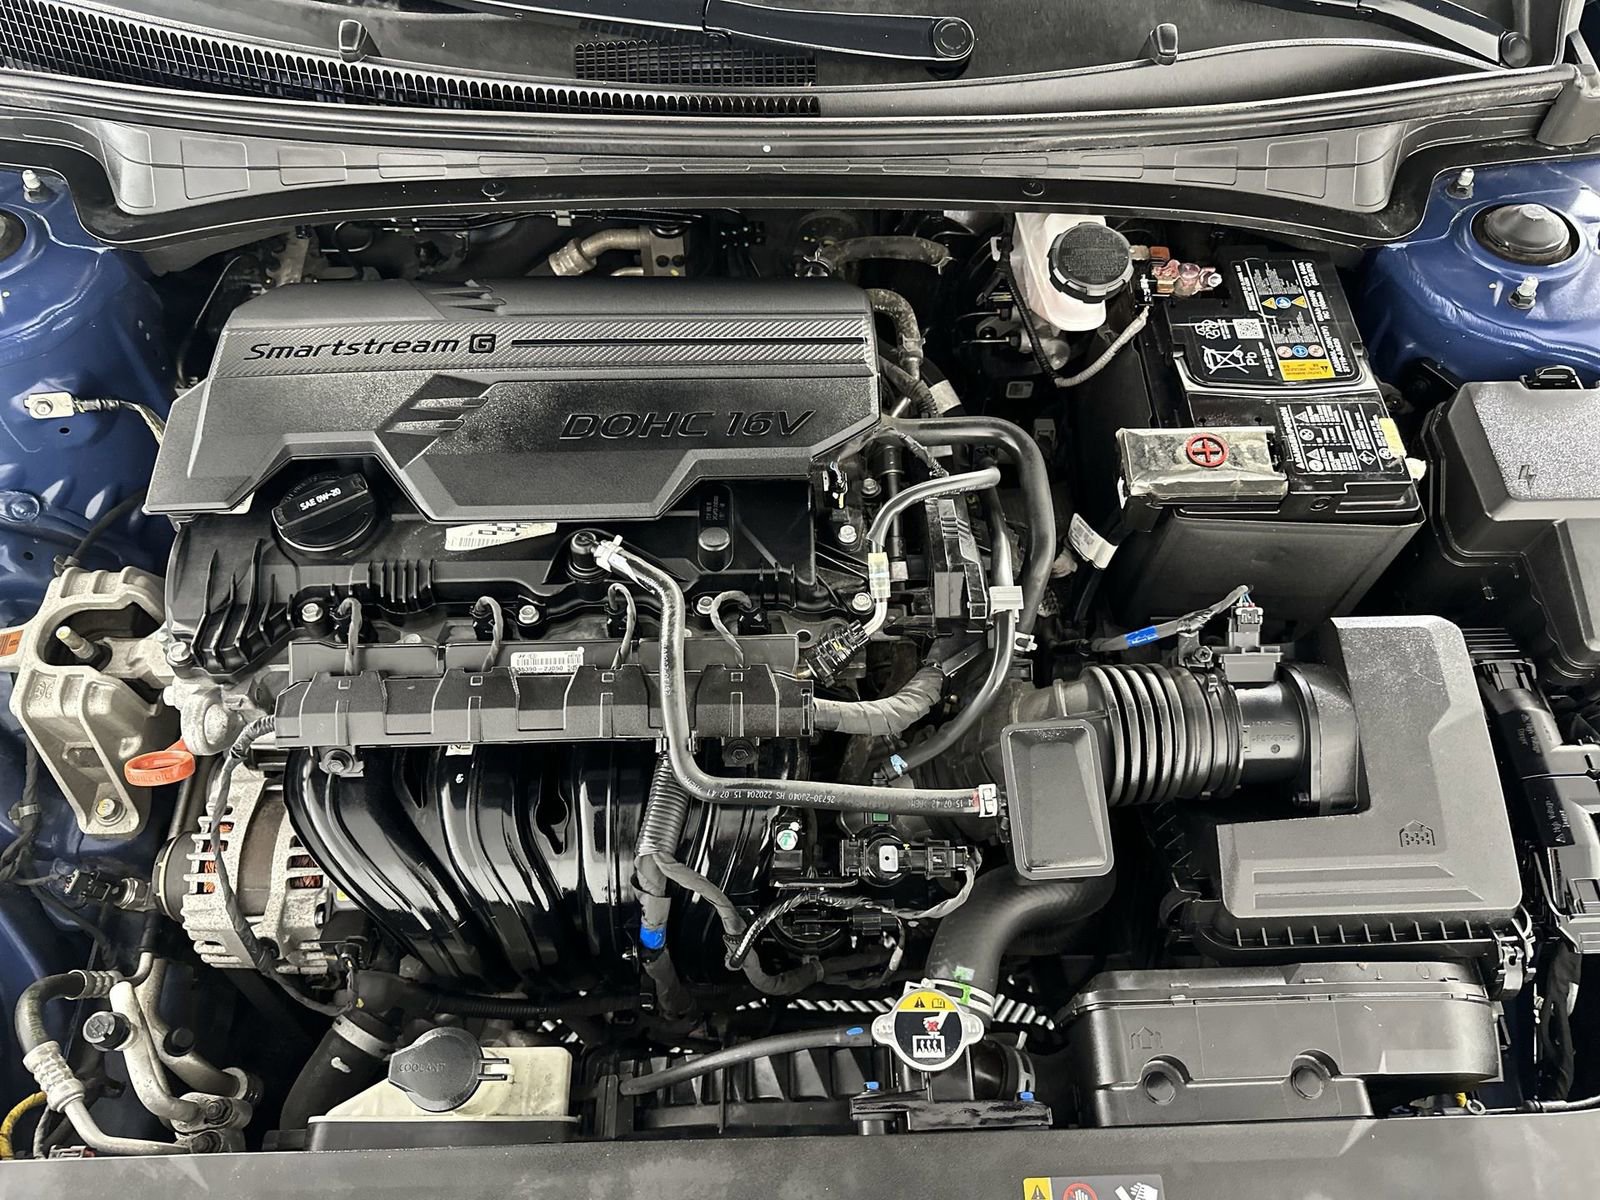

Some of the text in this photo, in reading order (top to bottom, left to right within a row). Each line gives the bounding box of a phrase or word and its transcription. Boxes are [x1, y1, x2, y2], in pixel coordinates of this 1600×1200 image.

[244, 335, 495, 360] Smartstream G
[1246, 351, 1260, 366] Pb
[560, 410, 816, 440] DOHC 16V
[299, 488, 342, 511] SAE 0W-20
[399, 1062, 446, 1073] COOLANT
